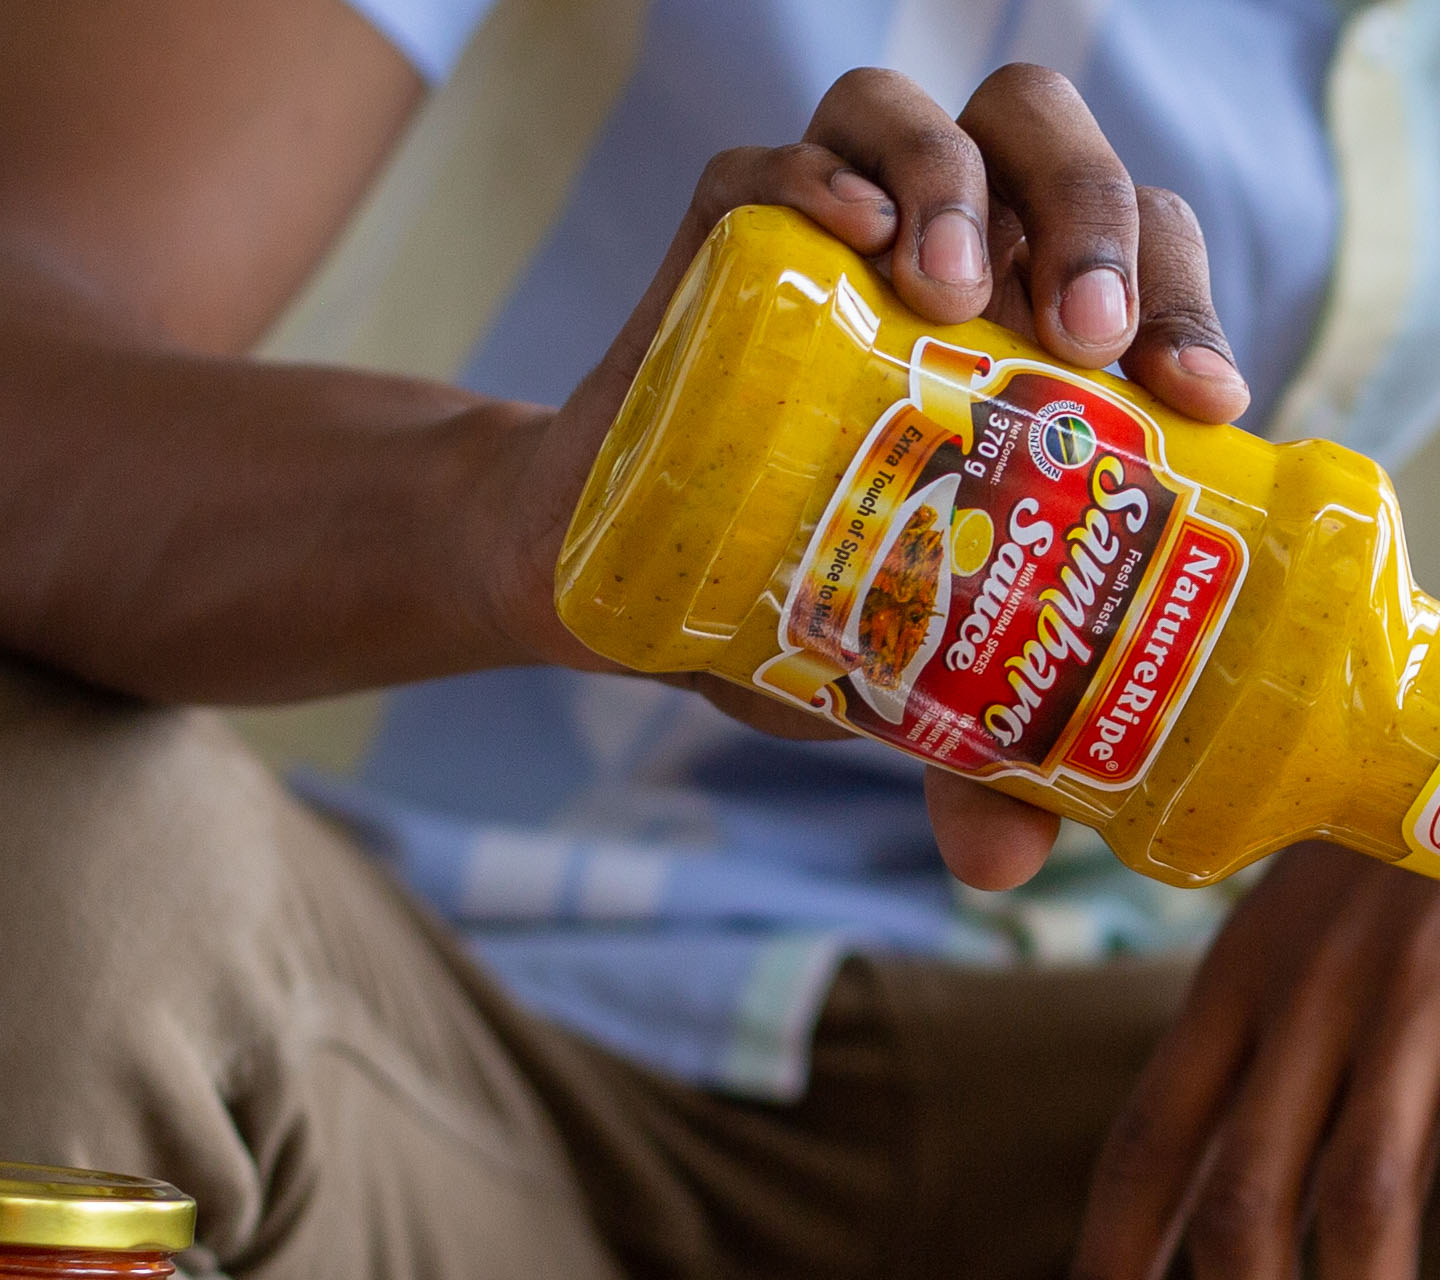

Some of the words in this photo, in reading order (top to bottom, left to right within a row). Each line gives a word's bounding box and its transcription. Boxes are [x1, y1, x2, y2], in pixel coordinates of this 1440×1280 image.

[1009, 420, 1024, 440] Net
[1037, 401, 1084, 420] PROUDLY
[885, 425, 923, 467] Extra
[978, 413, 1010, 458] 370
[1029, 421, 1061, 480] TANZANIAN
[964, 460, 986, 478] g
[990, 441, 1015, 486] Content:
[857, 471, 896, 517] Touch
[848, 521, 864, 540] of
[827, 539, 859, 582] Spice
[1112, 548, 1142, 592] Fresh
[820, 585, 839, 600] to
[946, 497, 1054, 671] Sauce
[984, 455, 1149, 747] Sambaro
[992, 589, 1025, 637] NATURAL
[1092, 595, 1123, 635] Taste
[972, 638, 999, 675] SPICES
